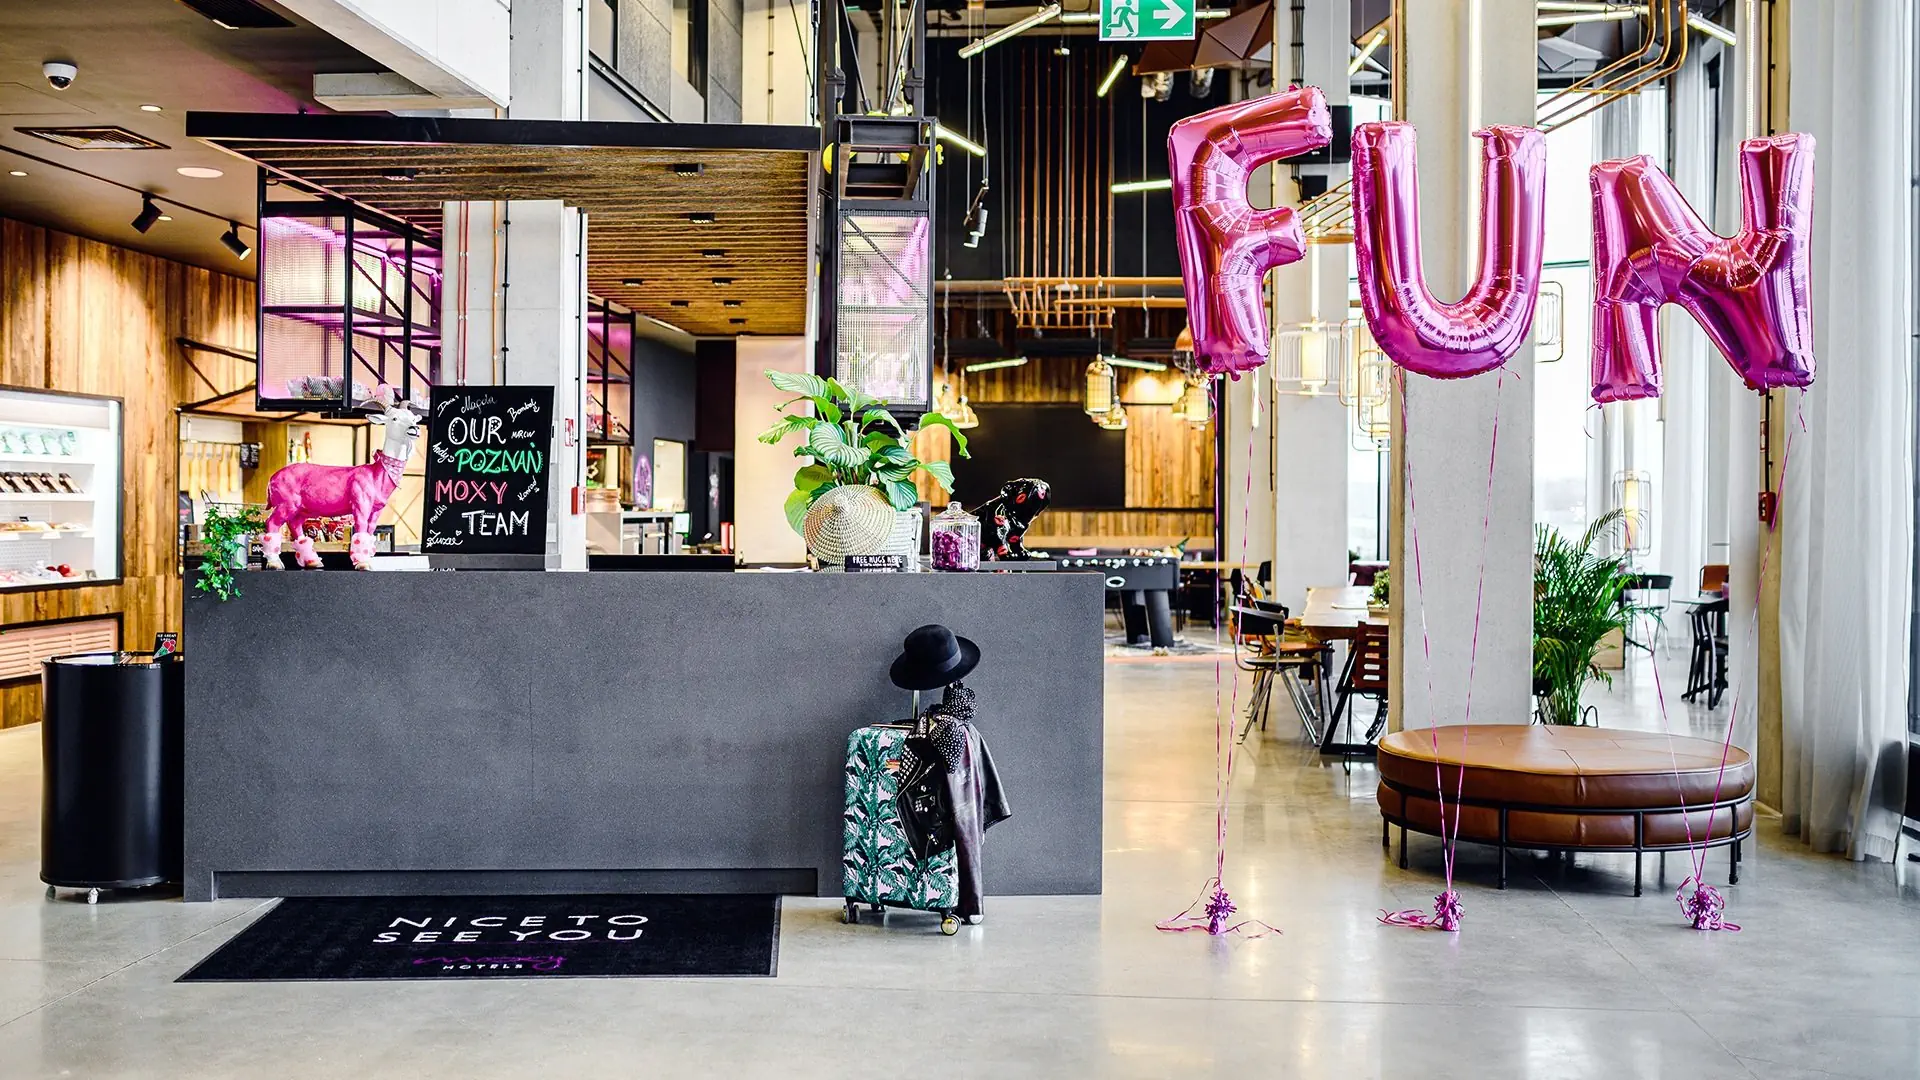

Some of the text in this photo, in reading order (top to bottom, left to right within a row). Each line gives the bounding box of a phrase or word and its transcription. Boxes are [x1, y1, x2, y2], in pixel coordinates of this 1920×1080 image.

[1168, 85, 1816, 404] FUN
[448, 416, 507, 445] OUR
[435, 479, 508, 505] MOXY
[461, 510, 530, 536] TEAM
[388, 914, 649, 928] NICE TO
[372, 929, 644, 943] SEE YOU
